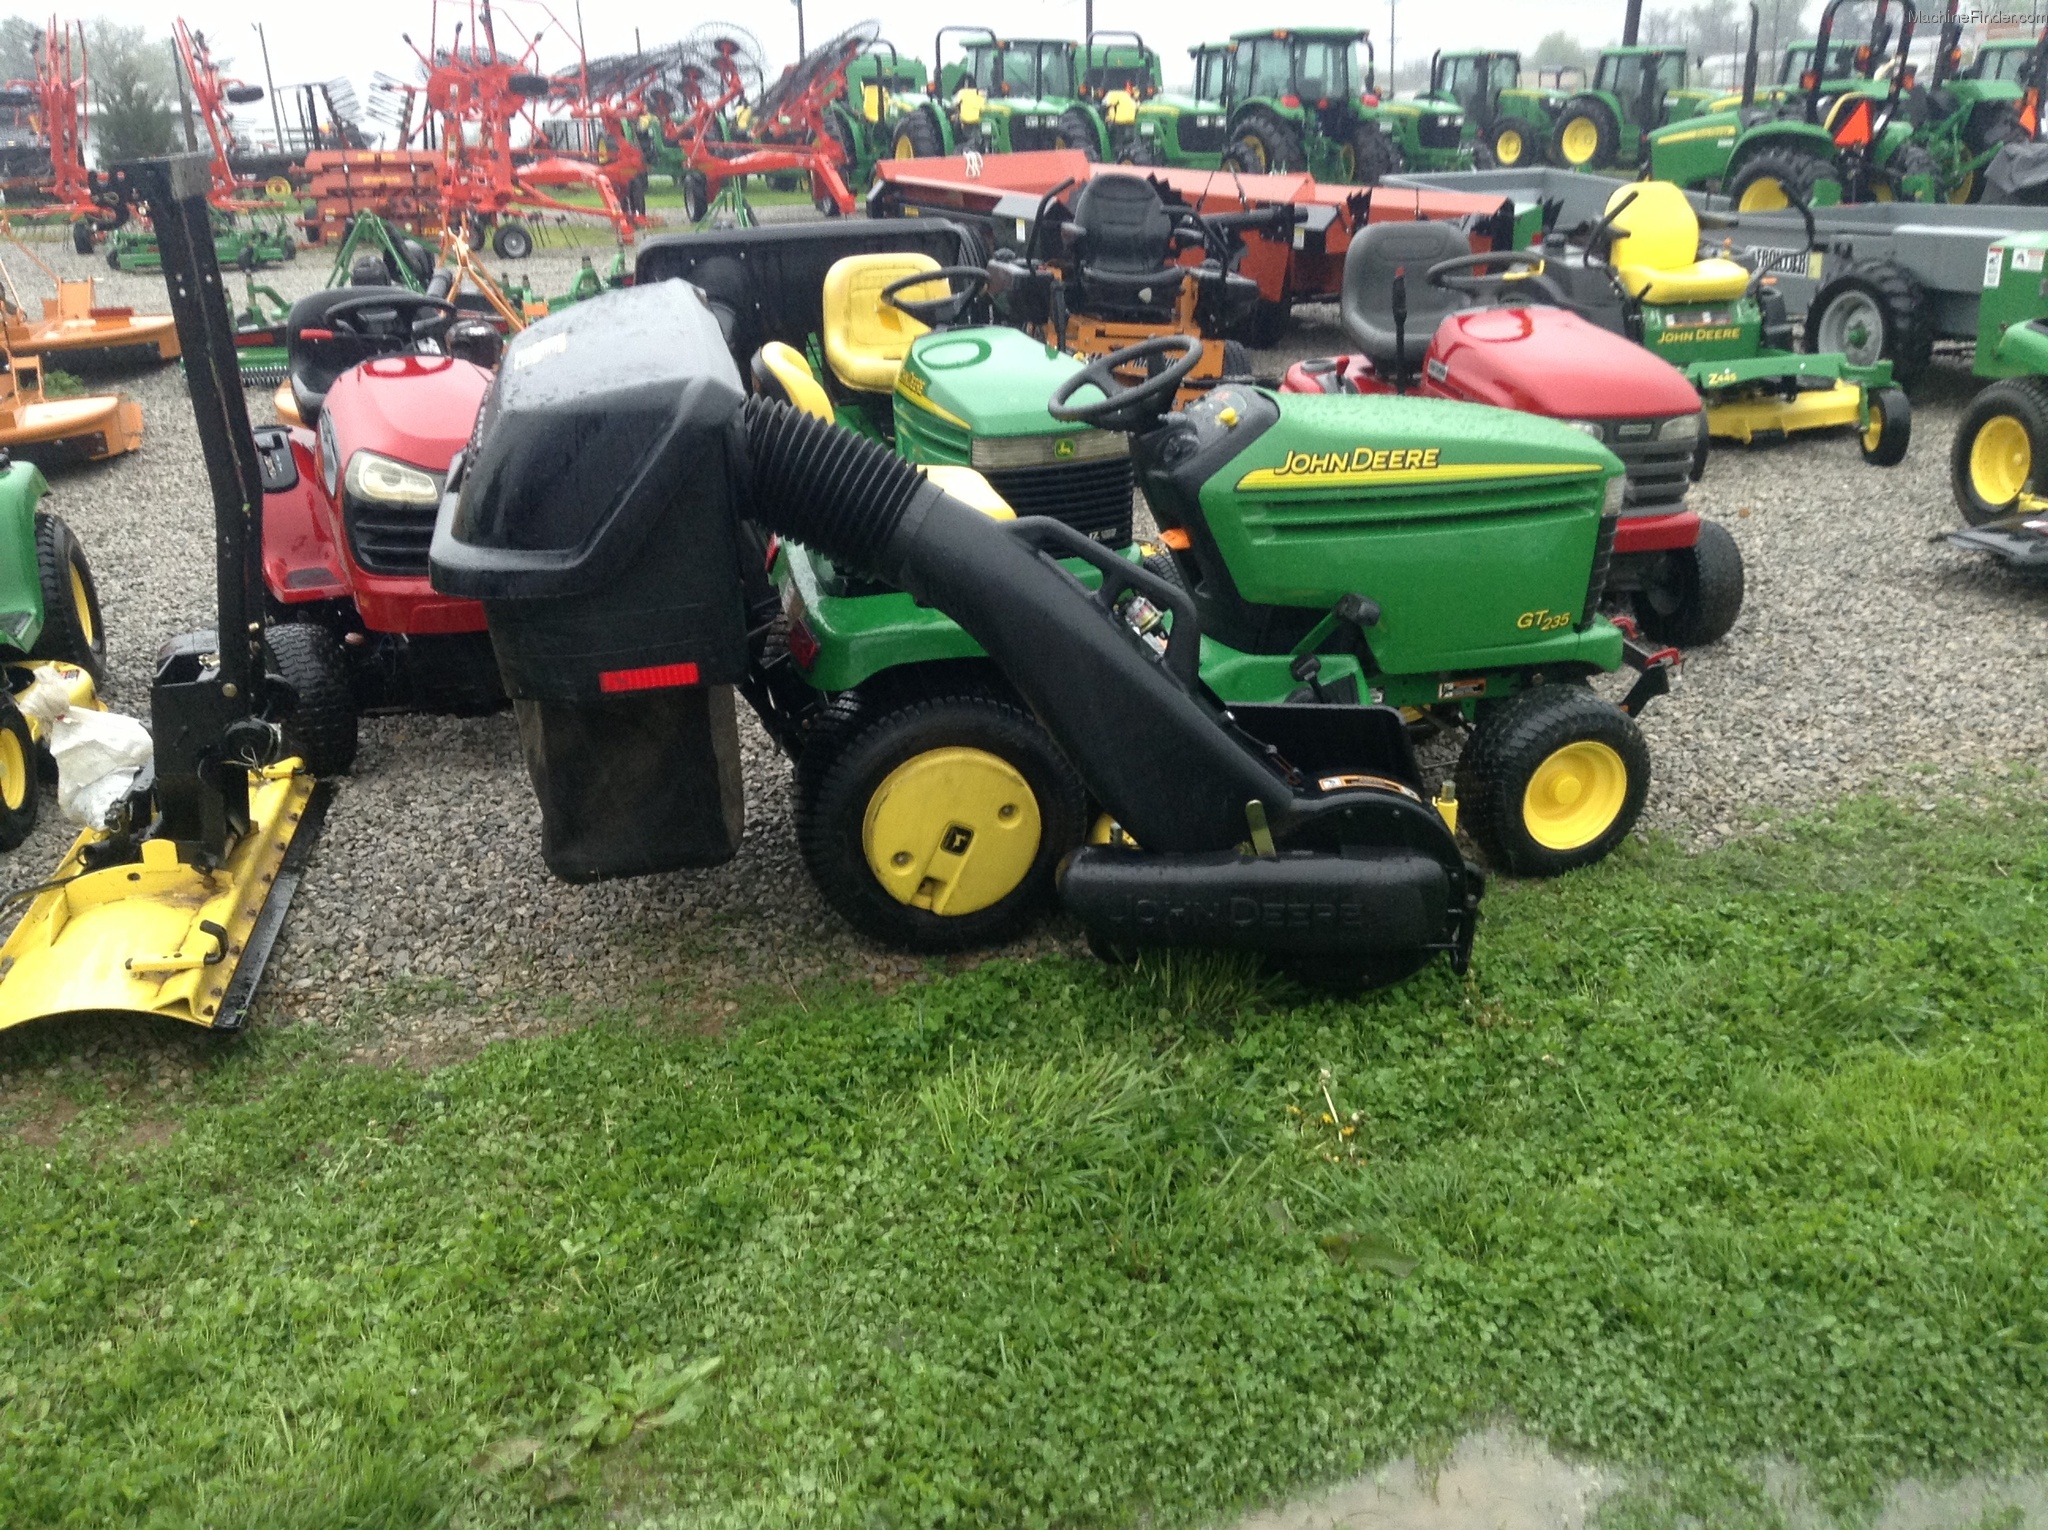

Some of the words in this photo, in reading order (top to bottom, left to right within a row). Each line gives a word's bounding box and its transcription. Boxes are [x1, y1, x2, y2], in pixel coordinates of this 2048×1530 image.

[1658, 332, 1693, 344] JOHN
[1696, 328, 1740, 340] DEERE
[1274, 450, 1350, 475] JOHN
[1351, 447, 1441, 472] DEERE
[1517, 609, 1571, 631] GT235
